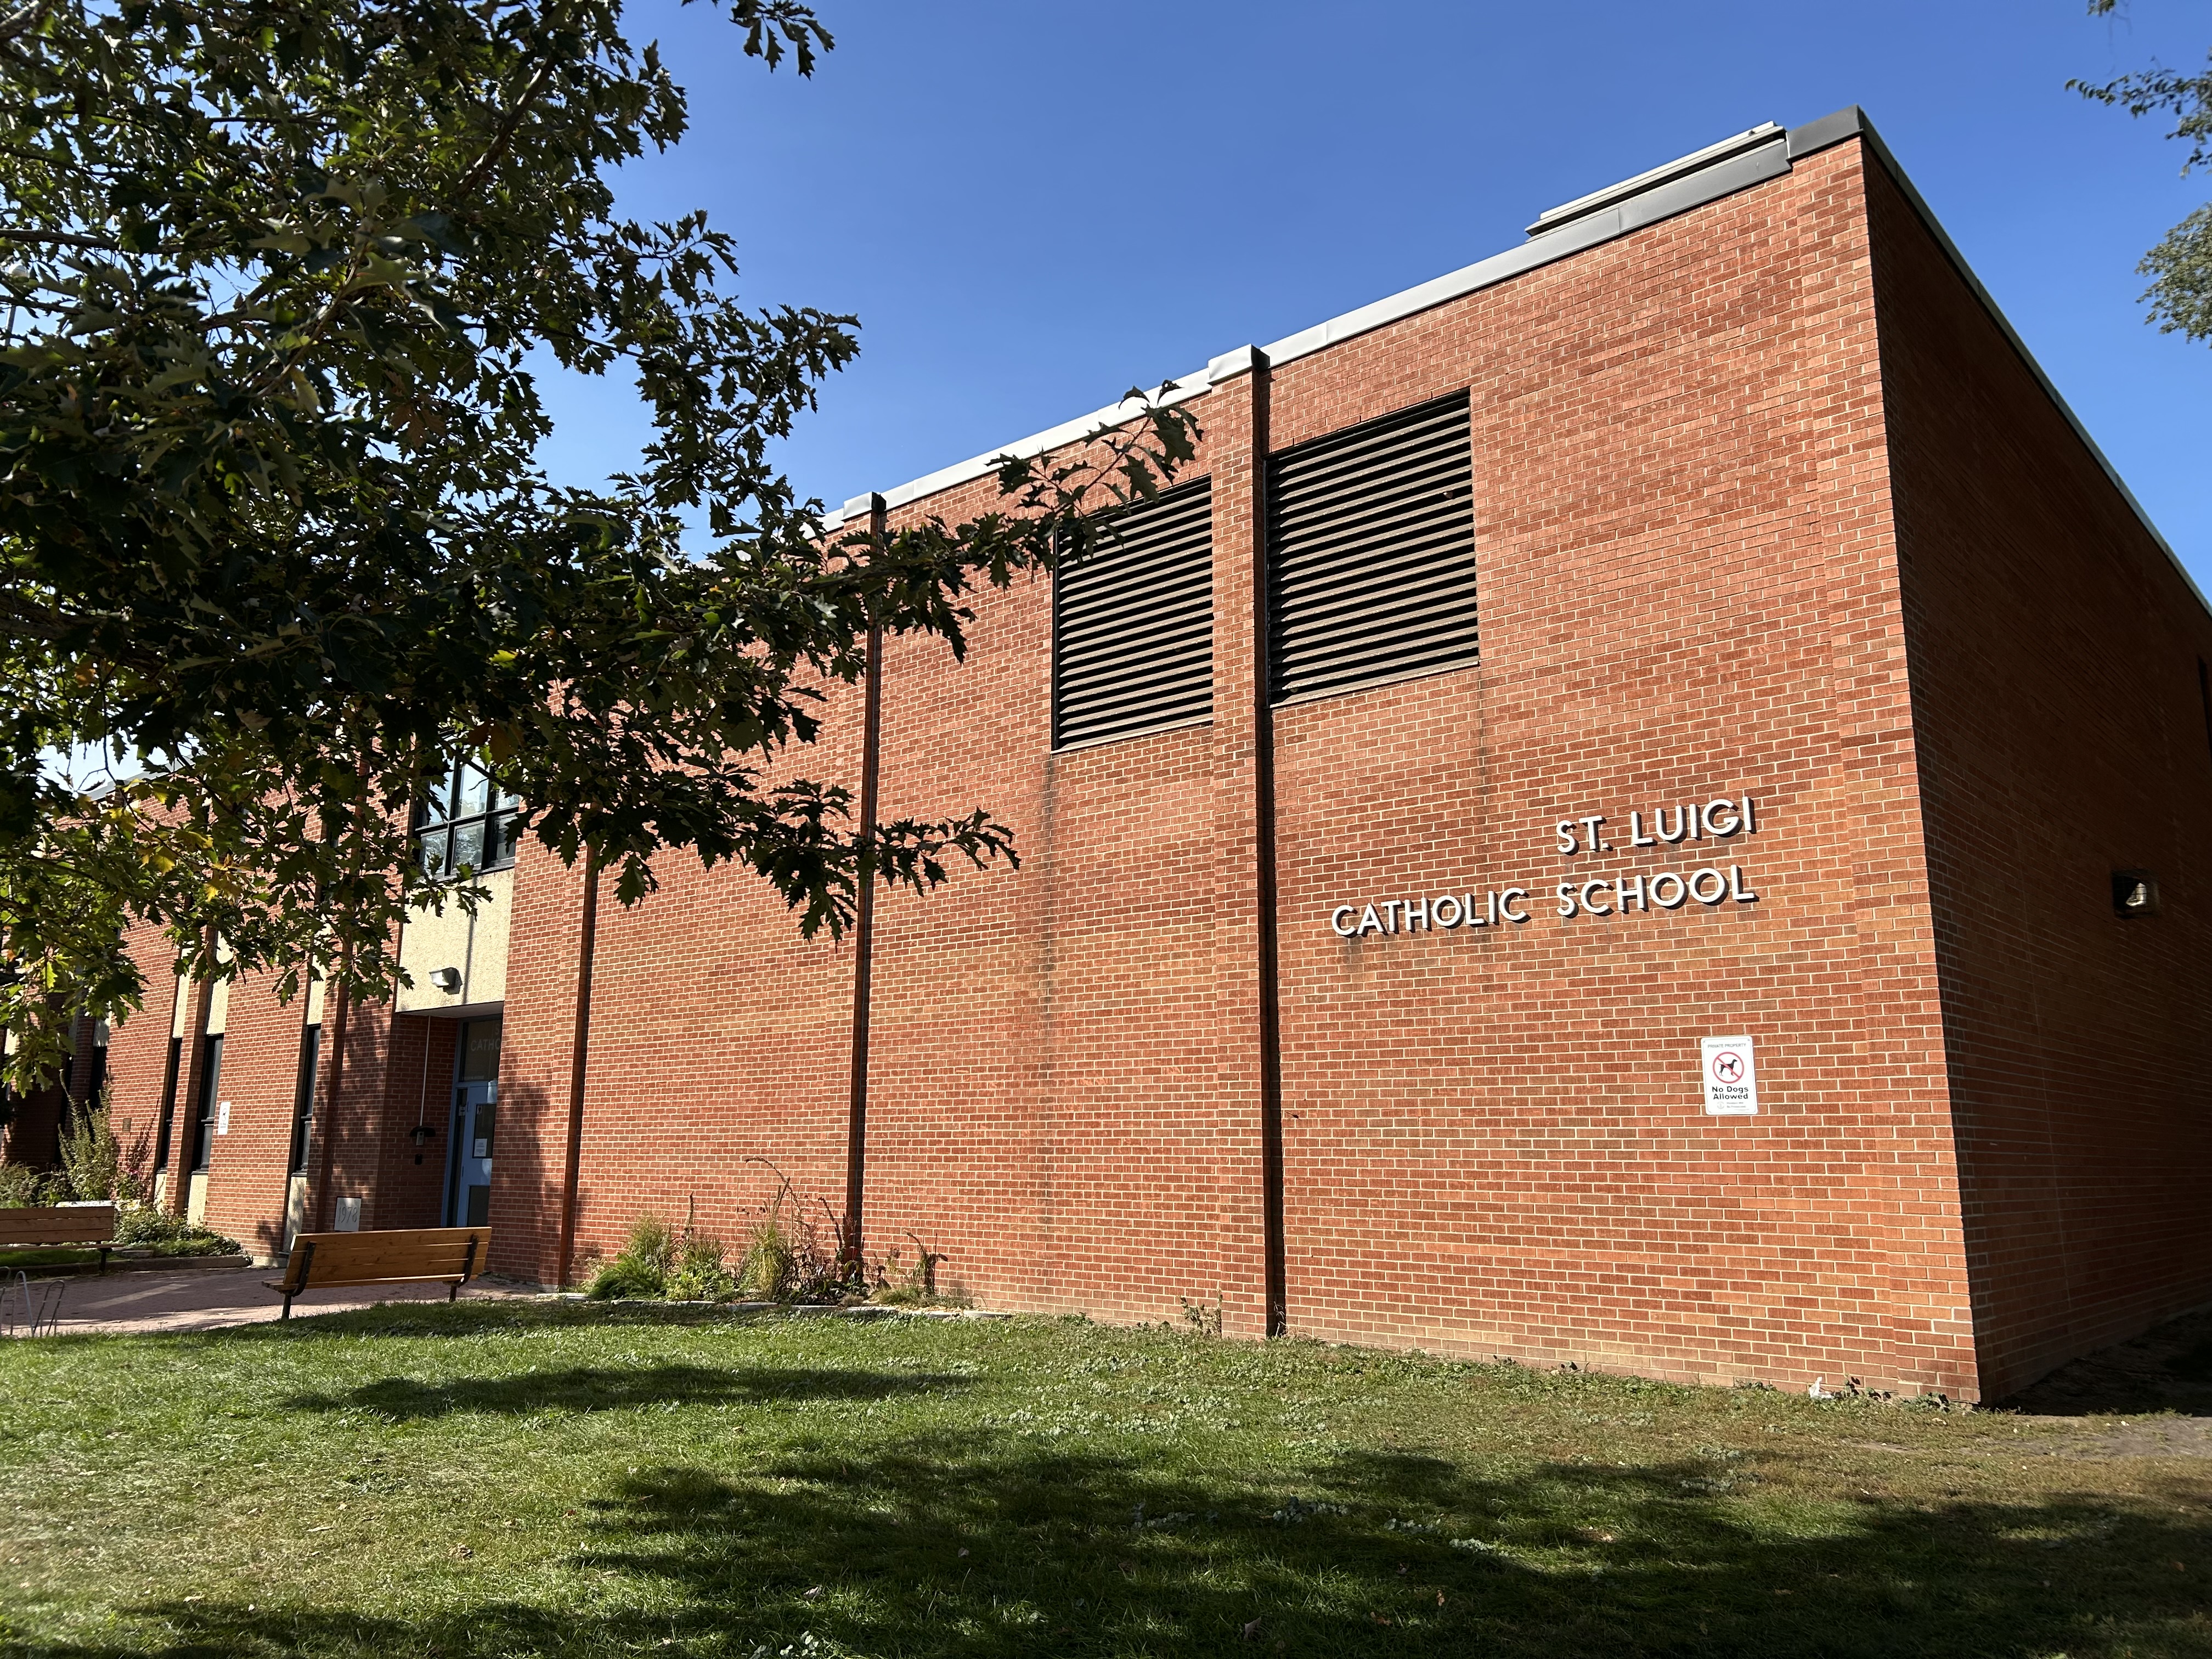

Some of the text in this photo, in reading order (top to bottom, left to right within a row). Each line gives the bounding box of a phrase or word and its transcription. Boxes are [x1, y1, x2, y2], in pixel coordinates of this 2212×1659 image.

[1556, 796, 1754, 854] ST. LUIGI
[1331, 865, 1757, 936] CATHOLIC SCHOOL
[337, 1206, 358, 1224] 1978
